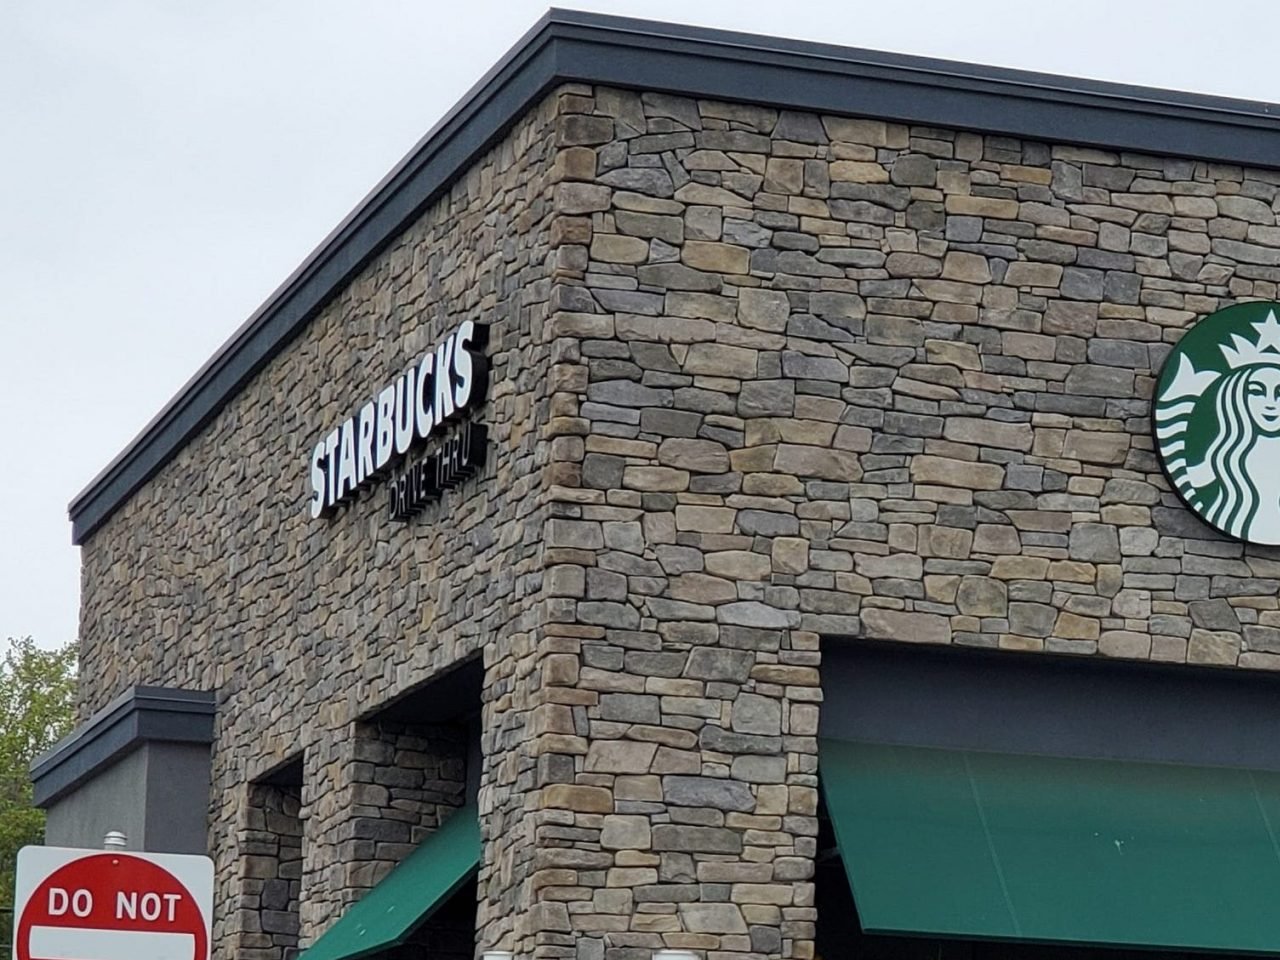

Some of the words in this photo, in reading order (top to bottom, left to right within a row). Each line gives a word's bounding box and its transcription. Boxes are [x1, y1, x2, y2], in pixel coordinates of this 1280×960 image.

[311, 320, 474, 519] STARBUCKS
[48, 888, 93, 918] DO
[116, 891, 182, 922] NOT
